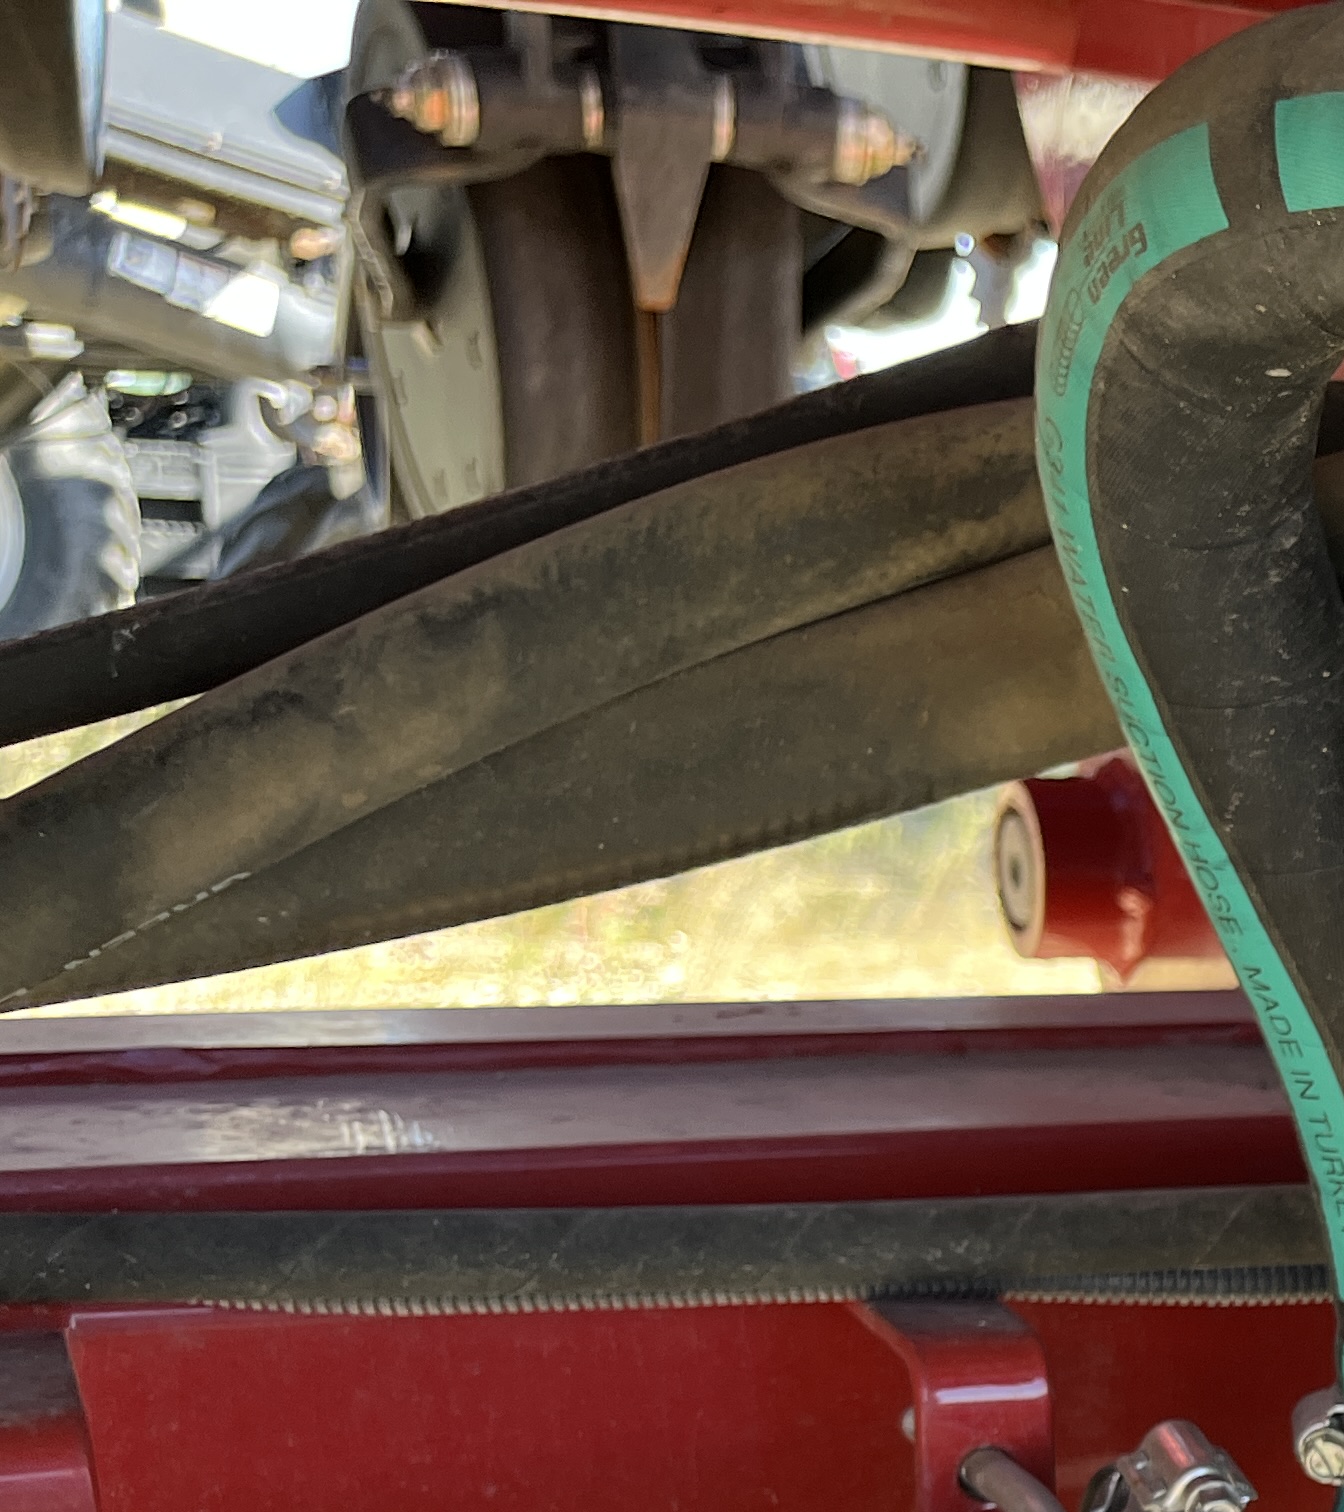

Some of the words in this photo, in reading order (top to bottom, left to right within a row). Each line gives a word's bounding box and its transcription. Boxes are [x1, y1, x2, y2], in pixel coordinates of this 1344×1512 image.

[1105, 672, 1191, 833] SUCTION
[1182, 839, 1245, 937] HOSE
[1242, 965, 1304, 1060] MADE
[1290, 1069, 1321, 1101] IN
